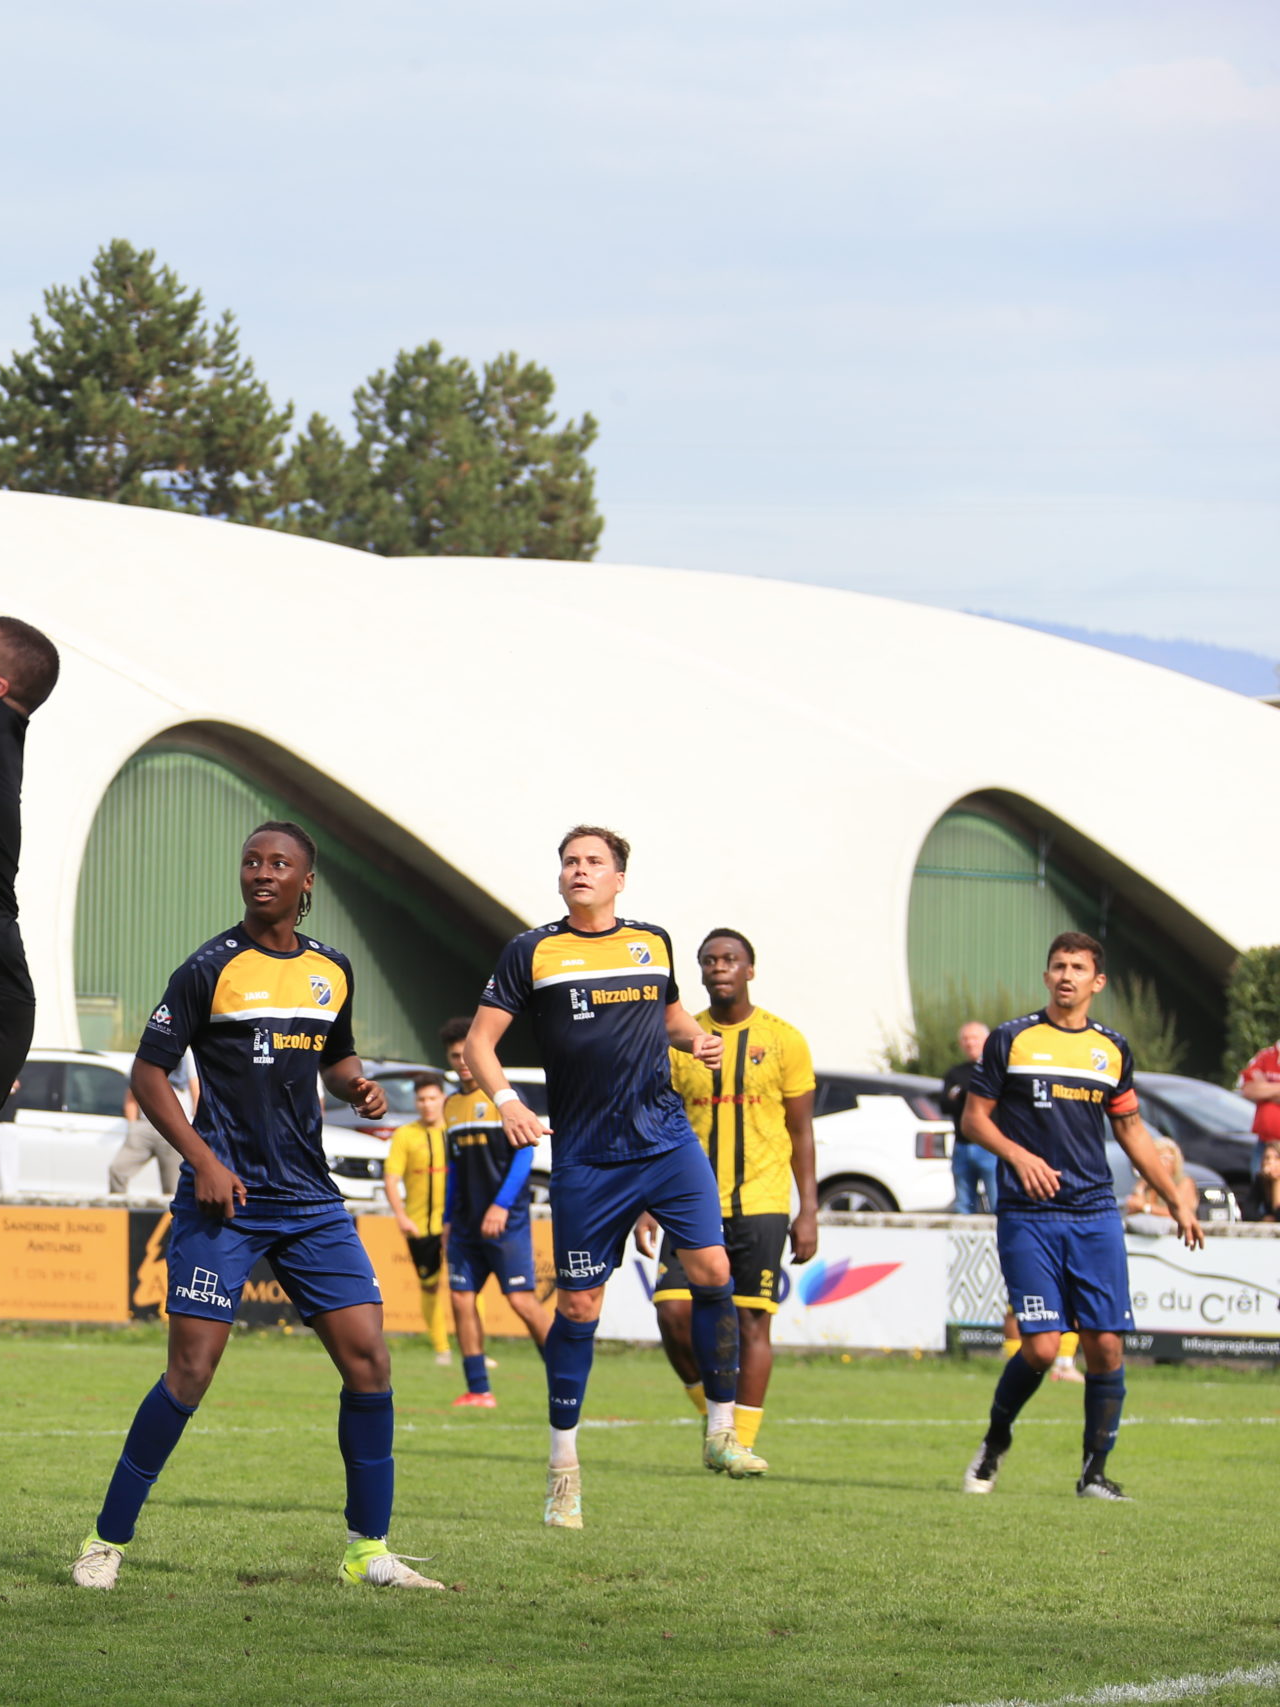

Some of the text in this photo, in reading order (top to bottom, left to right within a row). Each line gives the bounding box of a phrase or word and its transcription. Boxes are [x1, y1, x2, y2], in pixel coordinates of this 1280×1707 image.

[591, 985, 659, 1005] Rizzolo SA
[312, 1034, 327, 1052] S
[176, 1285, 232, 1309] FINESTRA
[1158, 1289, 1192, 1311] du
[1200, 1288, 1261, 1325] Crêt
